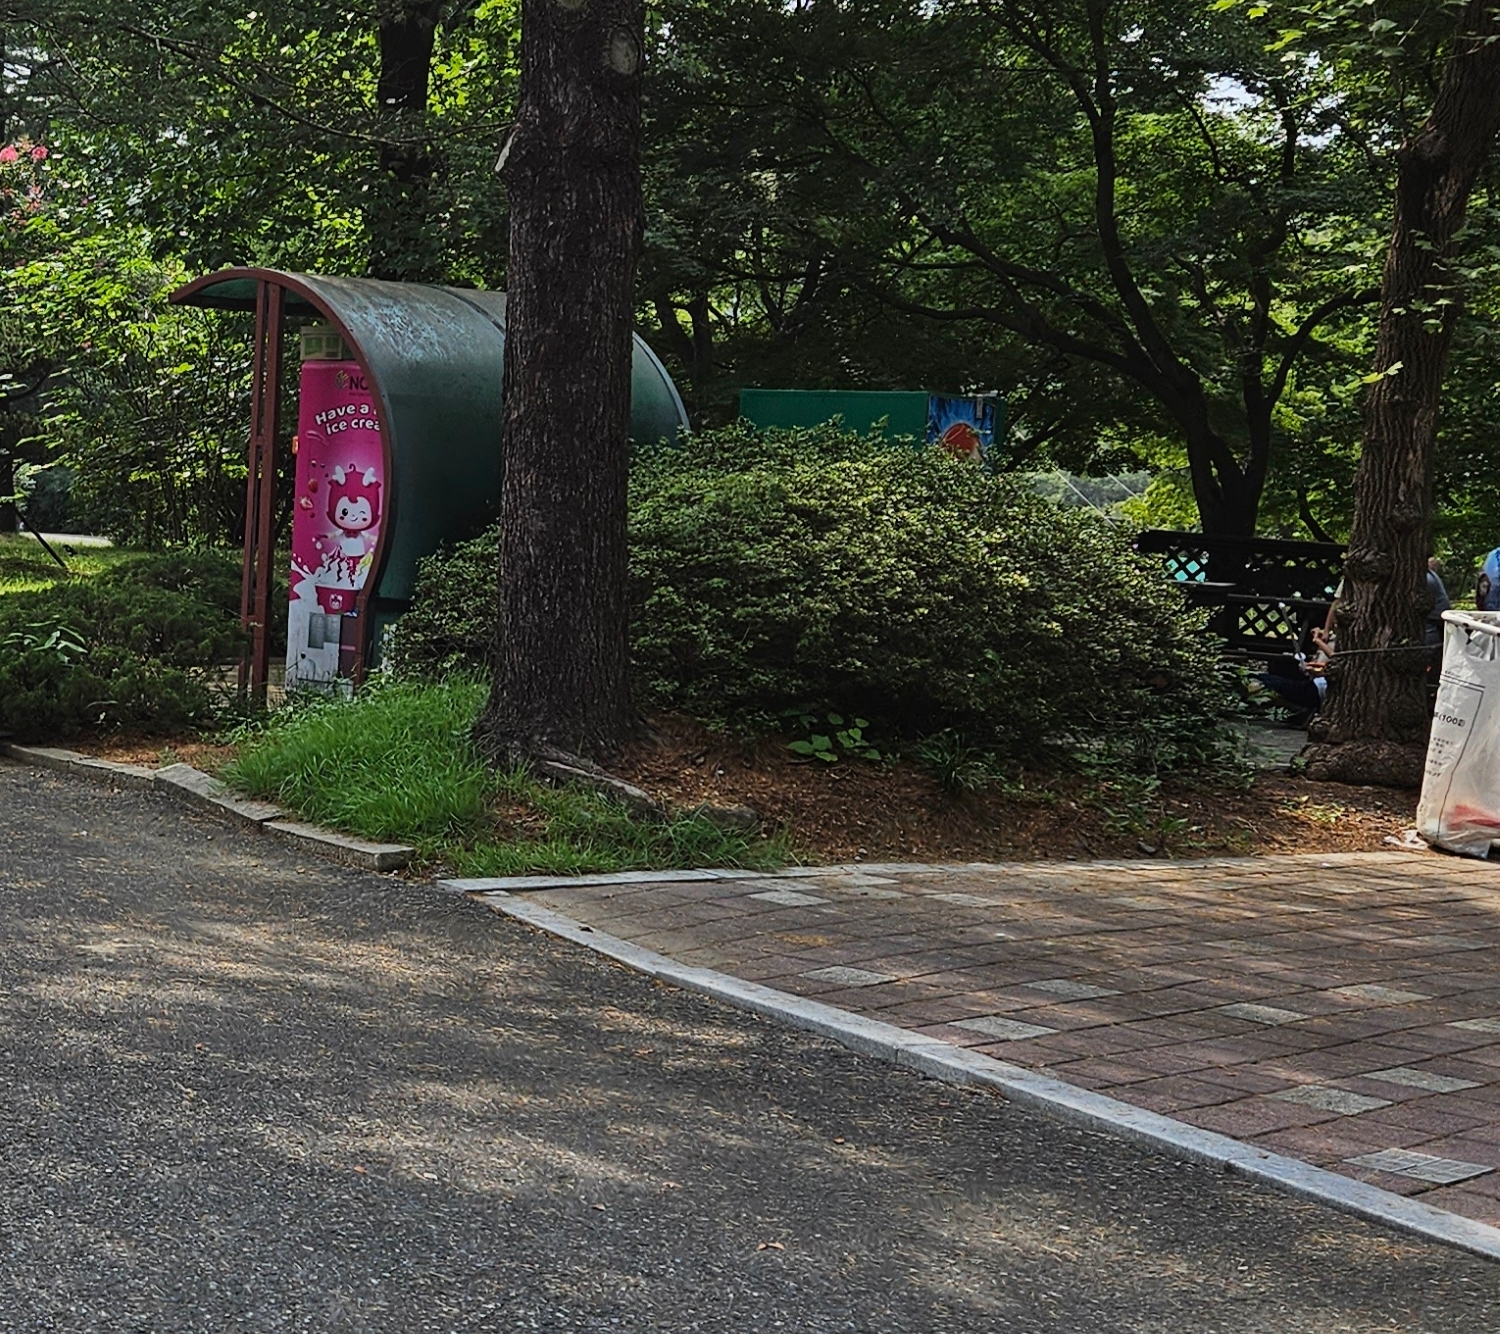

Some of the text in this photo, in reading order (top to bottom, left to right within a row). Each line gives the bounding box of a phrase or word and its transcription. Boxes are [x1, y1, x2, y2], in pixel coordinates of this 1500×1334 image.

[315, 404, 356, 425] Have
[359, 404, 369, 414] a
[326, 420, 348, 435] ice
